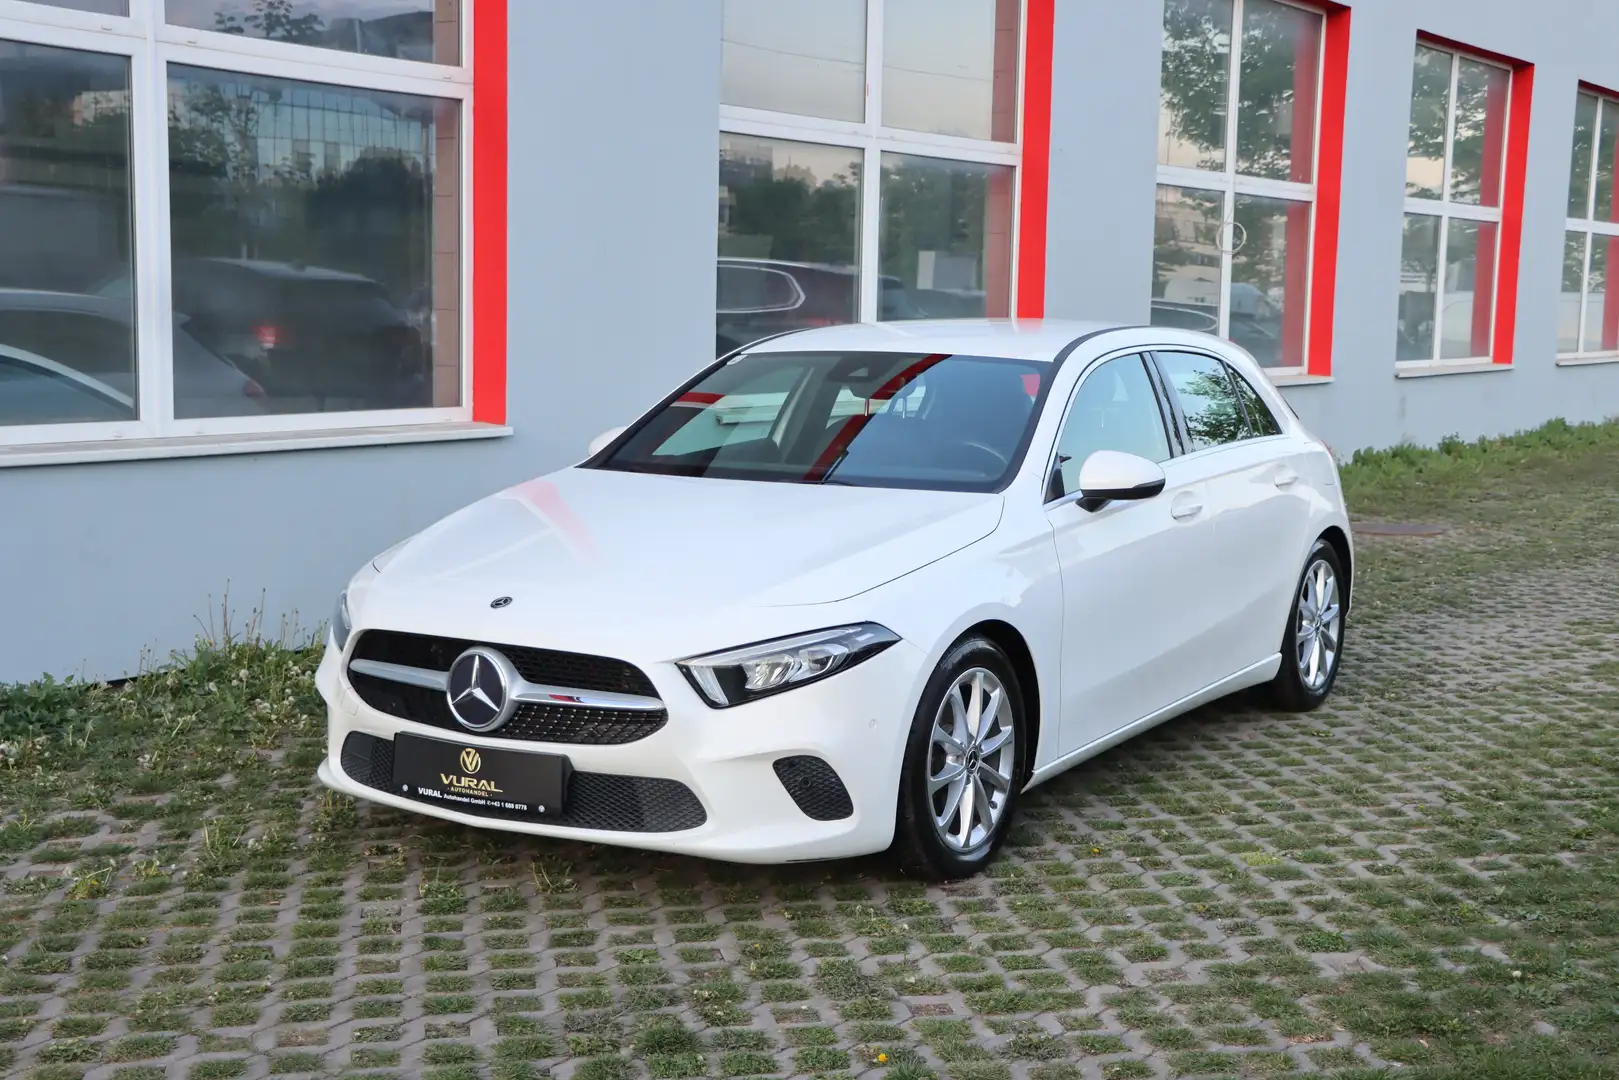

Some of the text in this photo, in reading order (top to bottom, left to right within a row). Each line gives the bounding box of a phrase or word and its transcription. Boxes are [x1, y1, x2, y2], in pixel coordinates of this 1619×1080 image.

[440, 773, 503, 793] VURAL
[418, 787, 442, 798] VURAL
[444, 794, 470, 803] Autohandel
[451, 787, 489, 797] AUTOHANDEL
